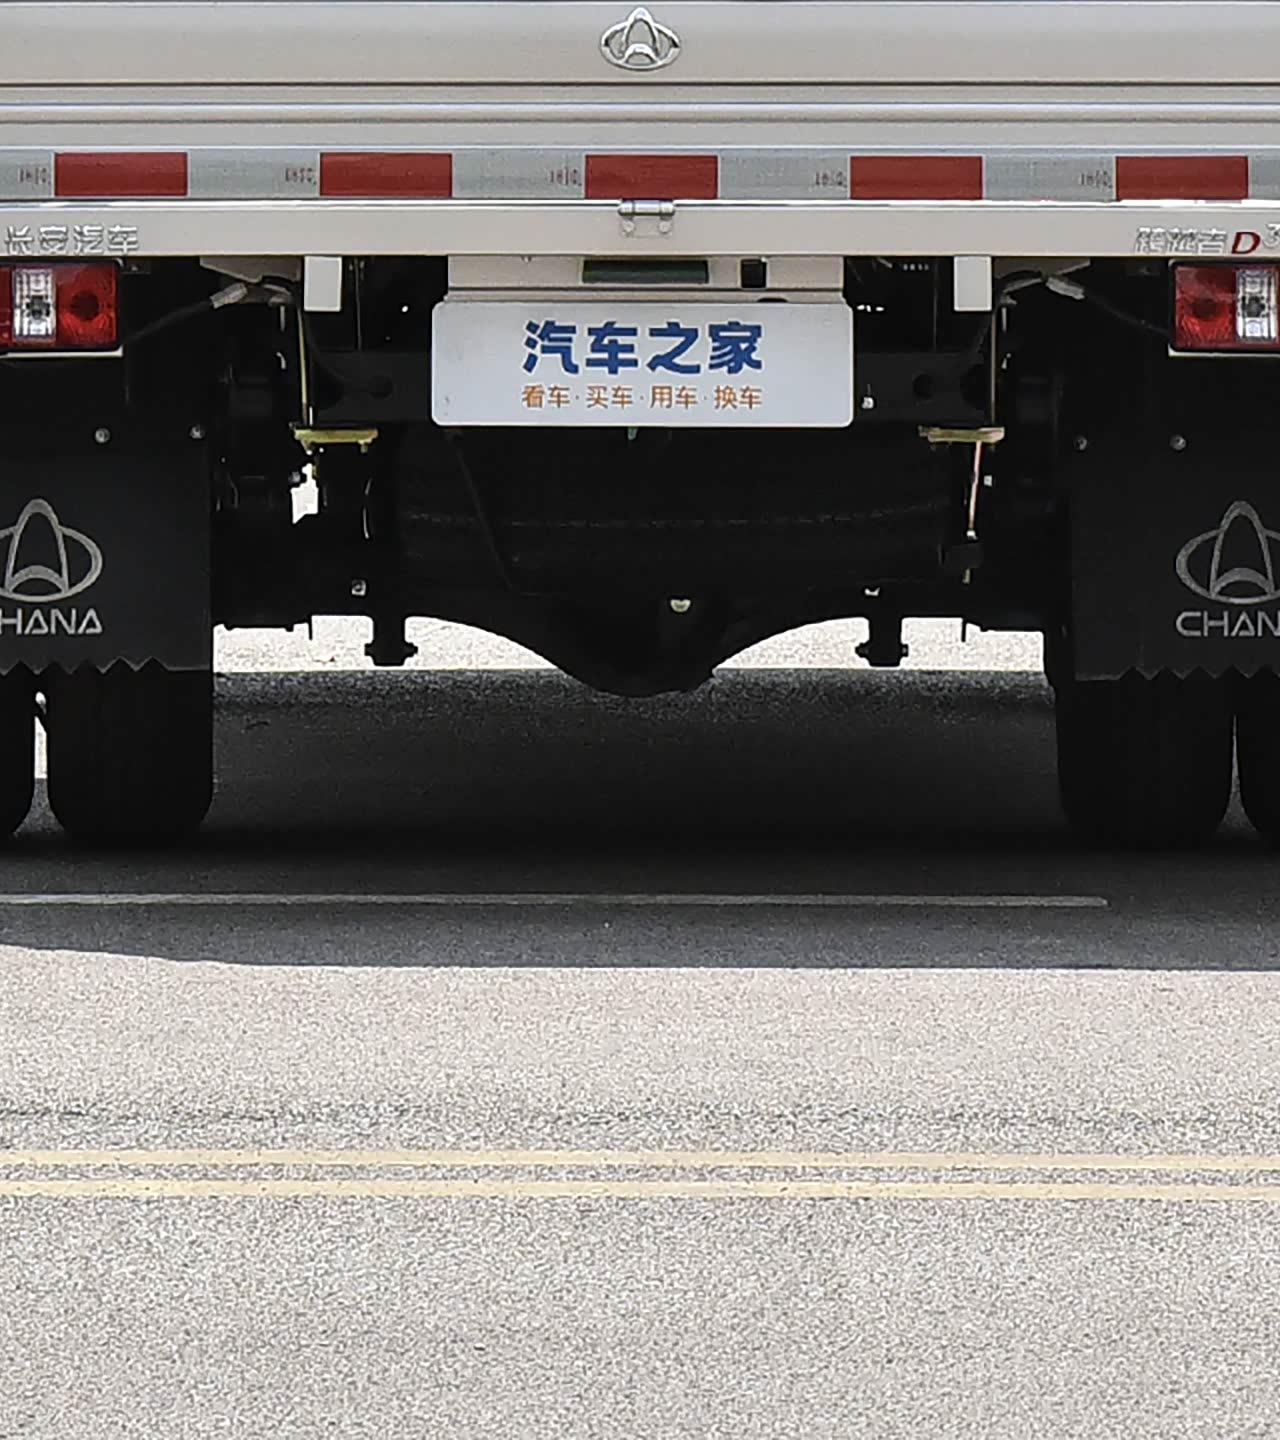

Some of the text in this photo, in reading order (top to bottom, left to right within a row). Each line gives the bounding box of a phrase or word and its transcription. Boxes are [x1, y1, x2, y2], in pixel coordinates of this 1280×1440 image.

[5, 224, 140, 255] 长安汽车
[522, 320, 763, 375] 汽车之家
